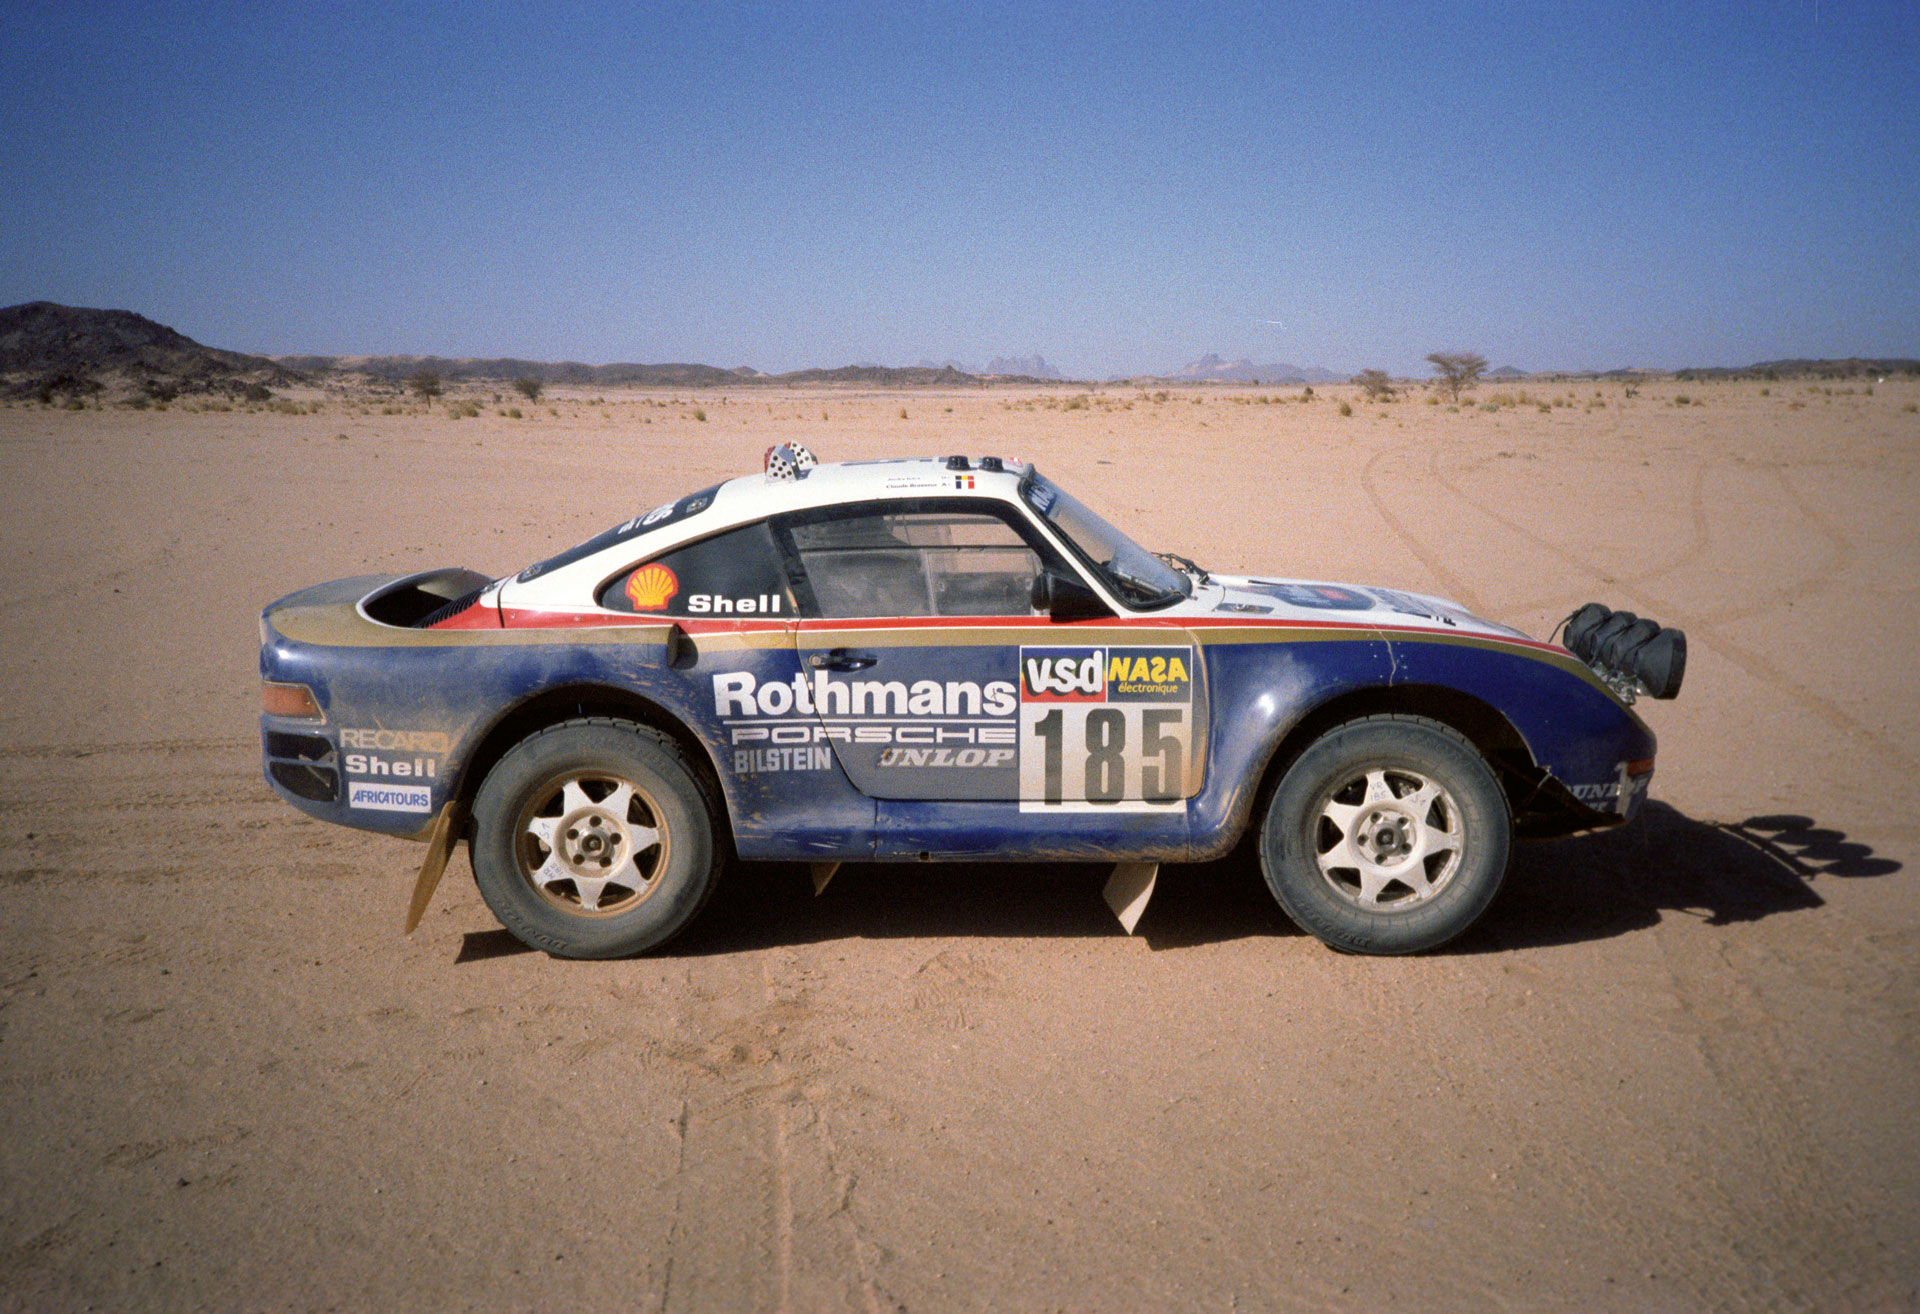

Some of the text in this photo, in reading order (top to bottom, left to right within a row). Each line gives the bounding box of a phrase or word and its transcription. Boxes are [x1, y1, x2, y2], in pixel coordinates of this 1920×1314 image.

[688, 594, 781, 613] Shell
[1027, 650, 1104, 693] vsd
[712, 669, 1017, 717] Rothmans
[1118, 681, 1179, 695] électronique
[340, 728, 449, 753] RECARO
[731, 726, 1017, 745] PORSCHE
[345, 754, 435, 777] Shell
[734, 746, 832, 774] BILSTEIN
[880, 747, 1016, 767] UNLOP
[1034, 708, 1183, 806] 185
[352, 789, 429, 807] AFRICATOURS
